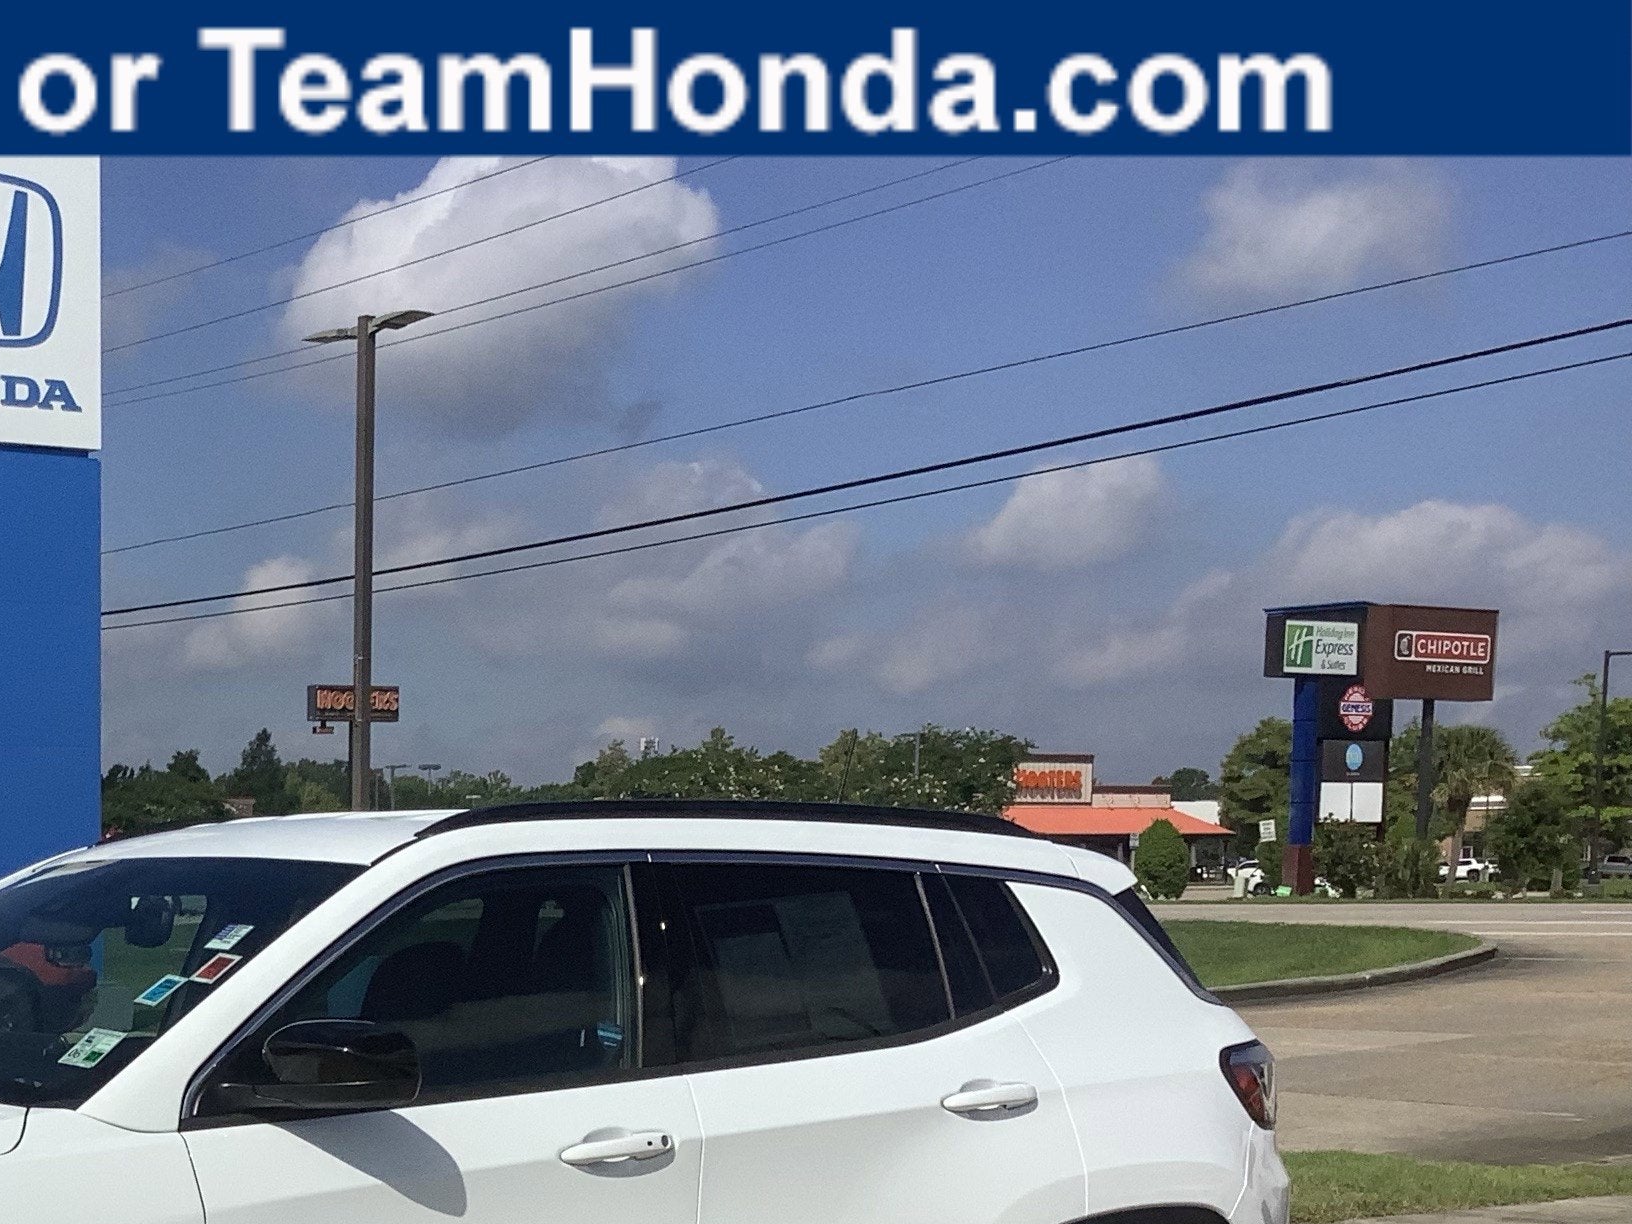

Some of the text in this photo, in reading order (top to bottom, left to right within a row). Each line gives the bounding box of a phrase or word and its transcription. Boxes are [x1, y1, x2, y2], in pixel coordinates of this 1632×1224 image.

[1315, 639, 1354, 657] Express
[1417, 639, 1486, 657] CHIPOTLE
[1425, 664, 1484, 675] MEXICAN GRILL
[316, 689, 398, 710] HOOERS
